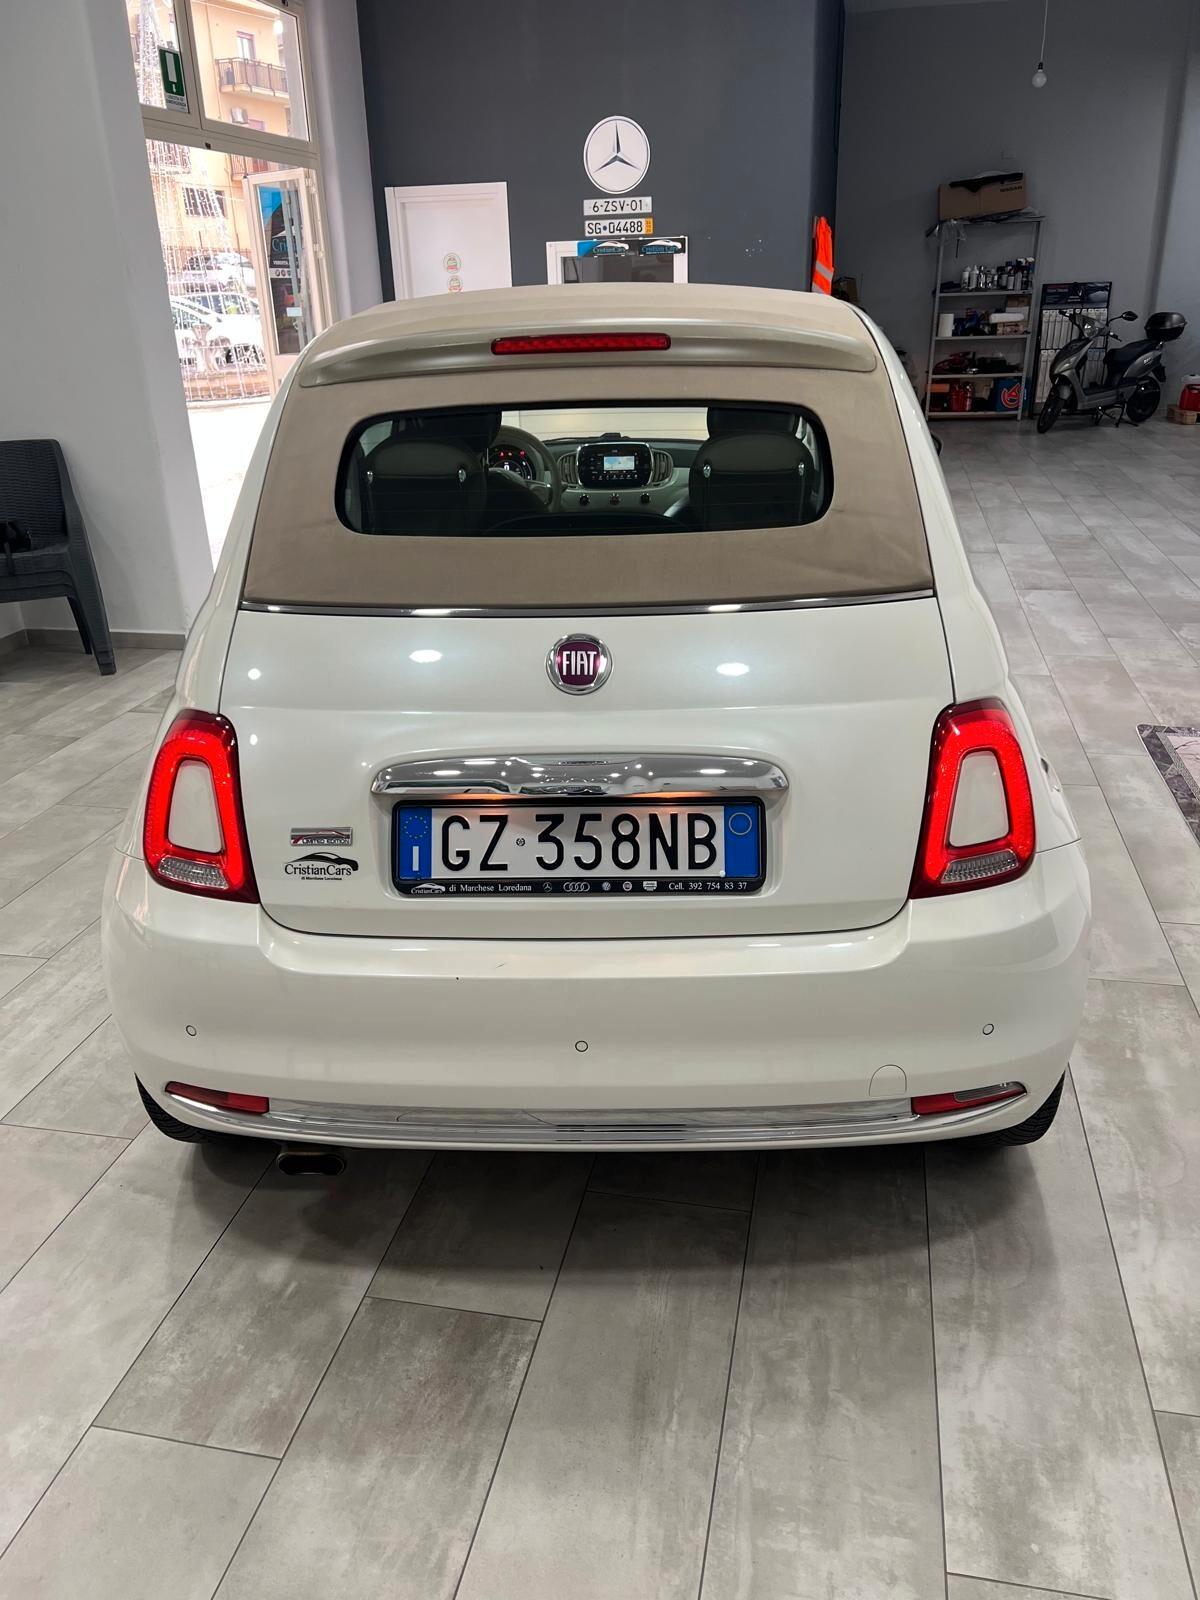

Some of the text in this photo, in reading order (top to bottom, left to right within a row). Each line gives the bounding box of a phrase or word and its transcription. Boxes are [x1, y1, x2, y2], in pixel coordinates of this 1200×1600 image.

[587, 222, 602, 235] SG
[562, 650, 597, 676] FIAT
[441, 812, 718, 872] GZ 358NB
[284, 863, 352, 876] CristianCars
[449, 884, 456, 892] di
[460, 884, 494, 892] Marchese
[498, 884, 532, 892] Loredana
[689, 882, 702, 890] 392
[707, 882, 720, 890] 754
[724, 882, 734, 890] 83
[737, 882, 747, 890] 37
